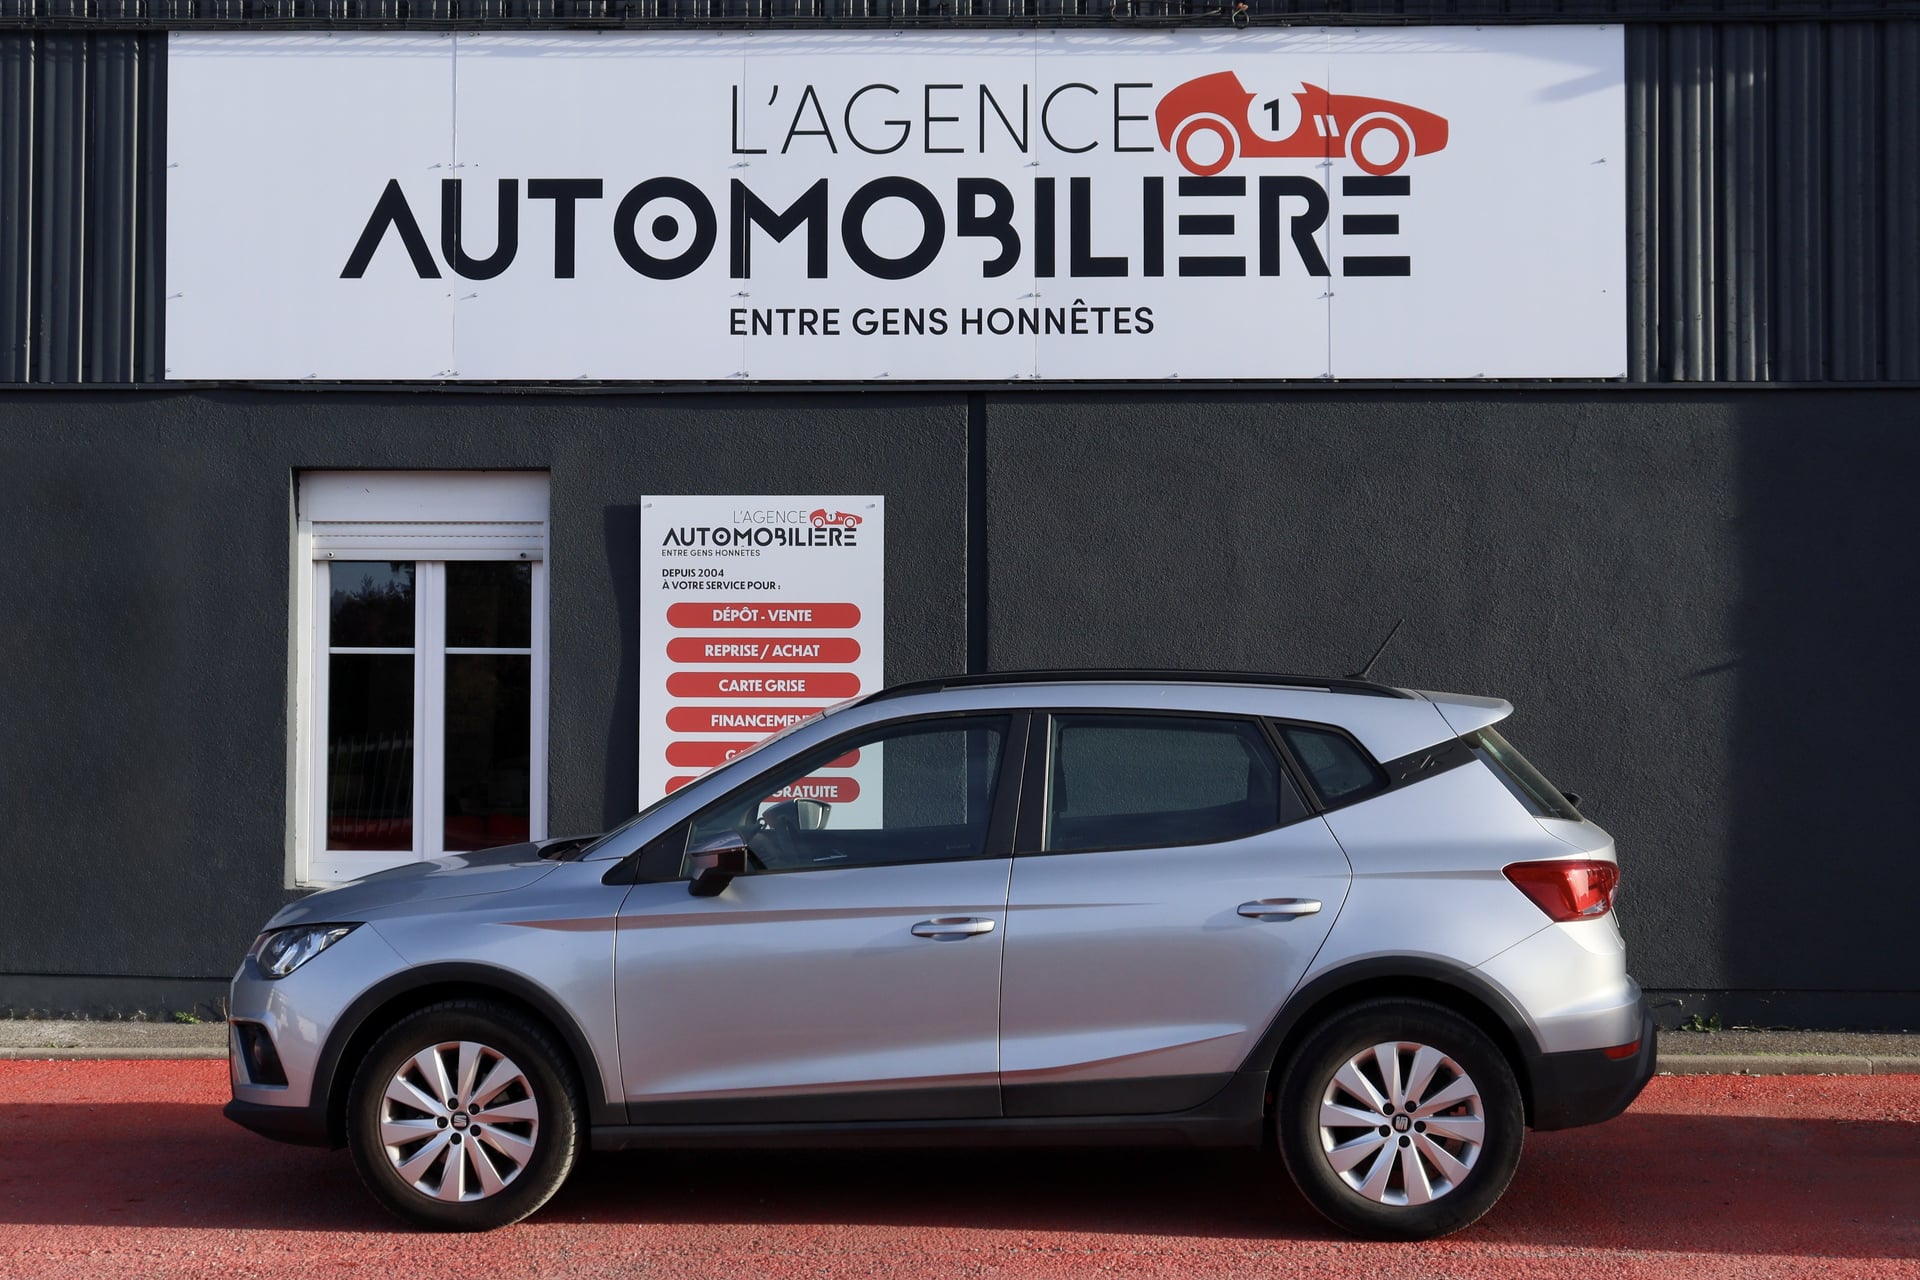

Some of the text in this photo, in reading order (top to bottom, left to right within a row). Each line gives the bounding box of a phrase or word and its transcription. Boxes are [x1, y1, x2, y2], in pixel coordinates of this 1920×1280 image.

[732, 83, 1154, 154] L'AGENCE
[1263, 98, 1280, 132] 1
[340, 175, 1411, 280] AUTOMOBILIERE
[730, 299, 1154, 336] ENTRE GENS HONNÊTES
[733, 510, 808, 524] L'AGENCE
[661, 545, 761, 557] ENTRE GENS HONNÊTES
[662, 568, 724, 578] DEPUIS 2004
[662, 579, 670, 590] À
[671, 581, 704, 590] VOTRE
[705, 581, 746, 590] SERVICE
[747, 581, 776, 590] POUR
[712, 606, 759, 622] DÉPÔT
[768, 609, 813, 622] VENTE
[704, 644, 759, 657] REPRISE
[772, 644, 820, 657] ACHAT
[718, 679, 806, 692] CARTE GRISE
